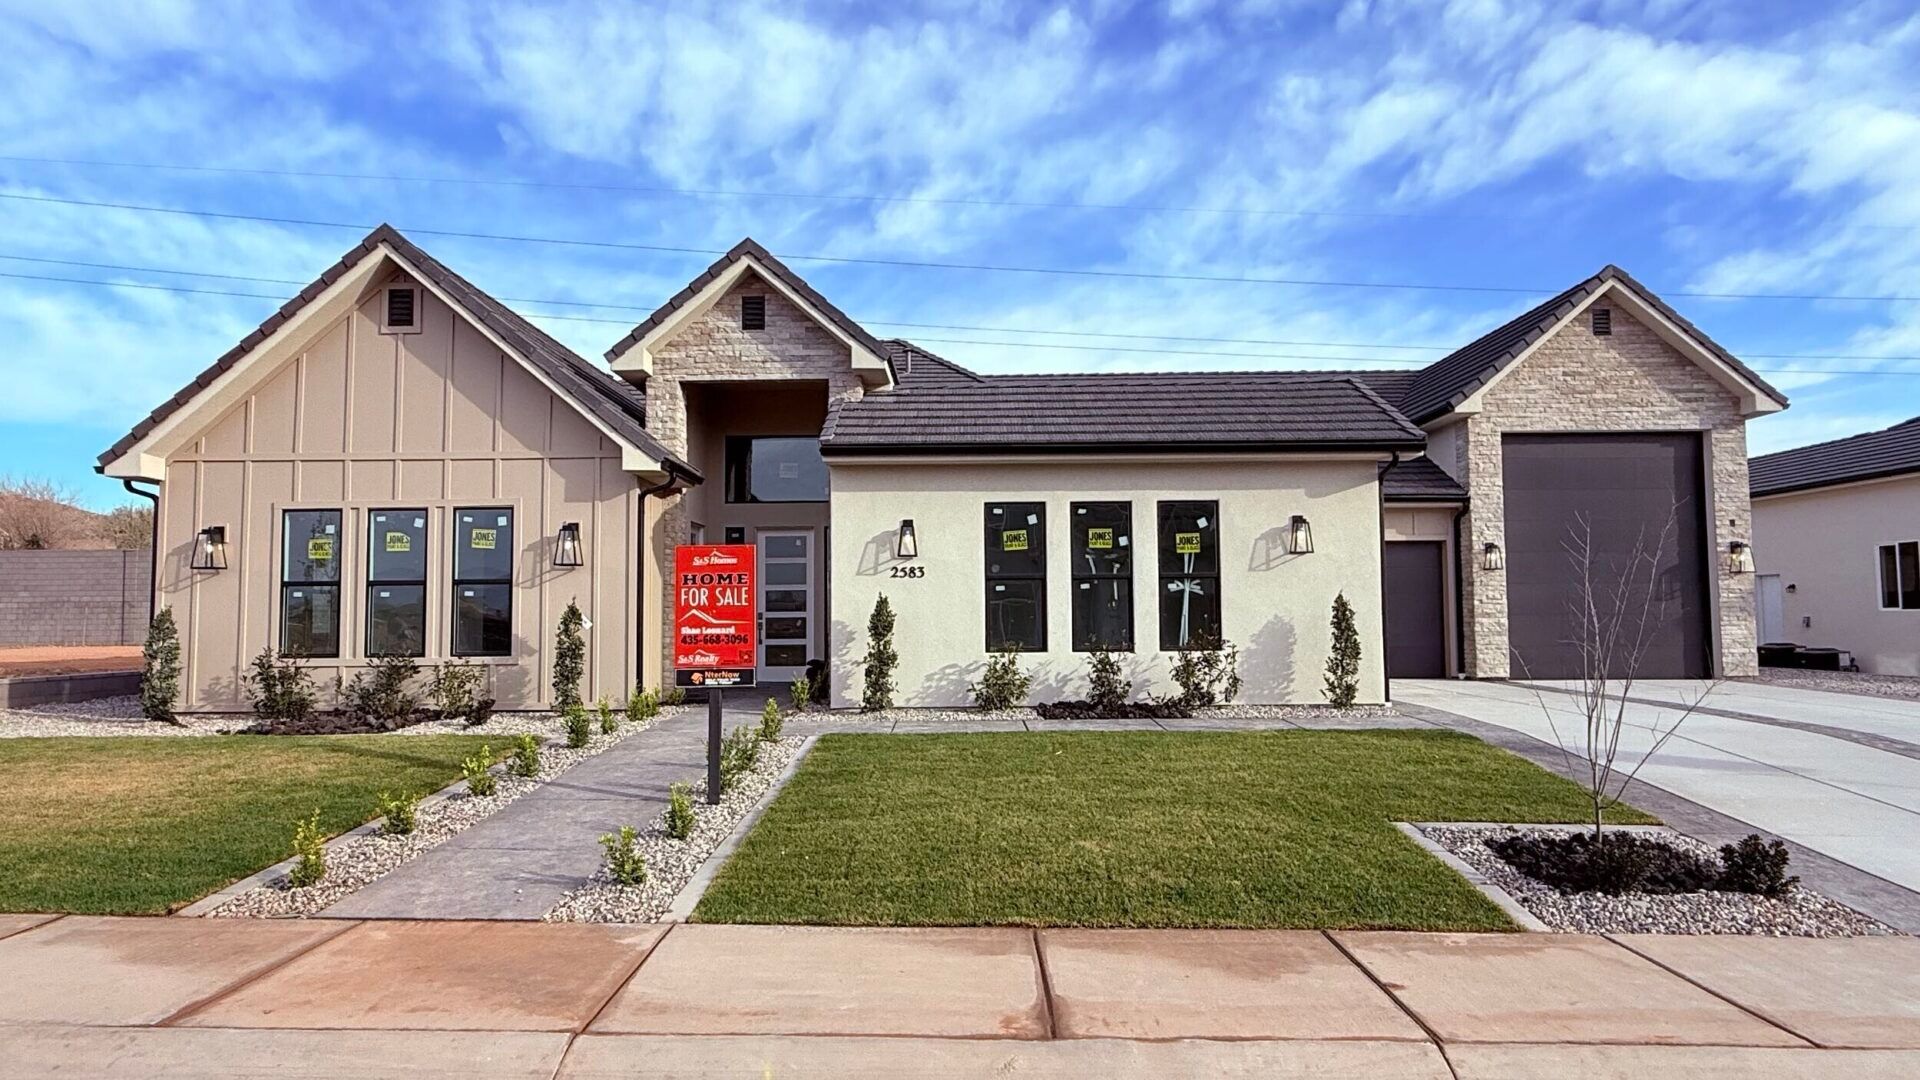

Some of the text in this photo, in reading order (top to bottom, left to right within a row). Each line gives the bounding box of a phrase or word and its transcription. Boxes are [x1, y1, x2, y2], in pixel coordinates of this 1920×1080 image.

[388, 535, 410, 544] JONES
[474, 531, 495, 541] JONES
[1005, 533, 1026, 543] JONES
[1090, 531, 1111, 540] JONES
[1178, 536, 1199, 545] JONES
[310, 542, 332, 551] JONES
[890, 566, 925, 578] 2583
[682, 573, 748, 585] HOME
[681, 587, 749, 607] FOR SALE
[681, 634, 749, 645] 435-668-3096
[694, 655, 720, 665] Realty
